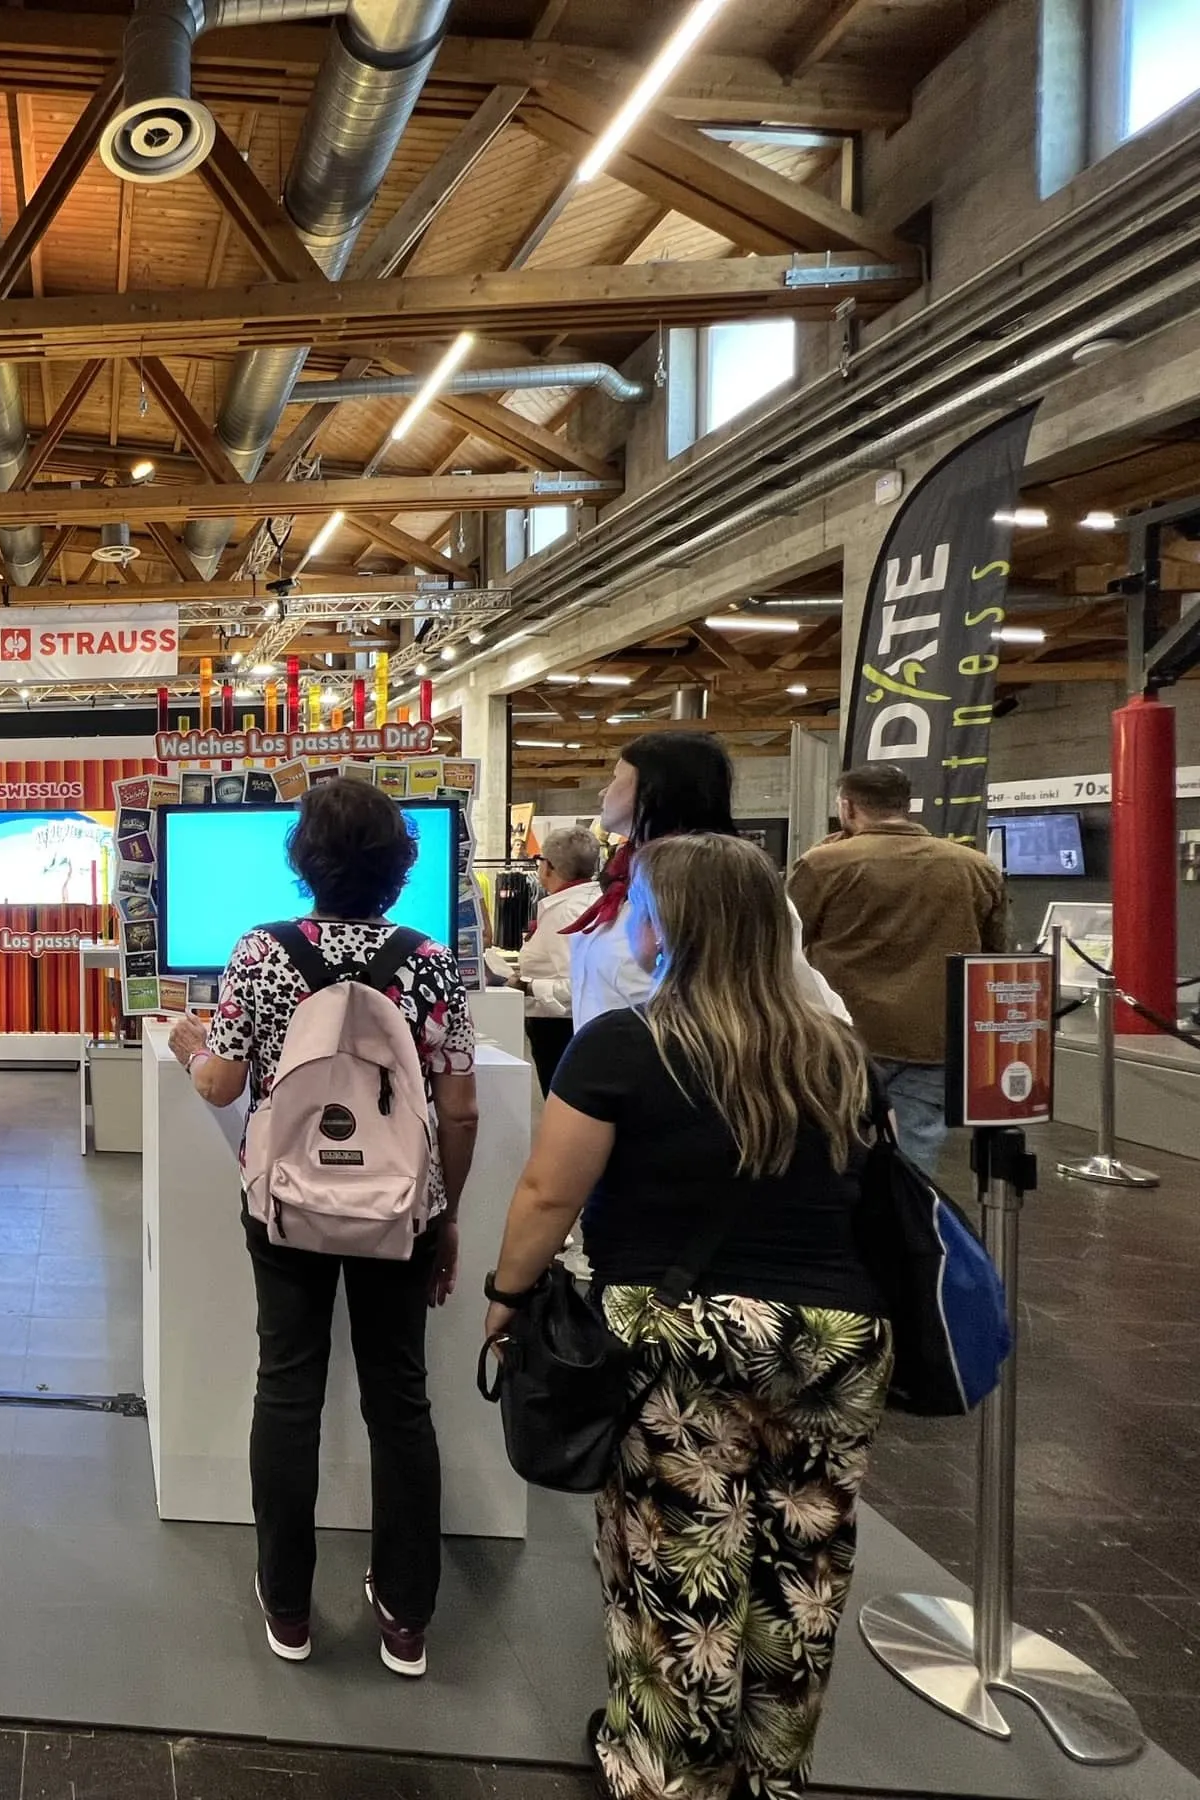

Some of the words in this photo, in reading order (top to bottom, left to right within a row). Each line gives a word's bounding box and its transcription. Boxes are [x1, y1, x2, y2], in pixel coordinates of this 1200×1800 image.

[39, 628, 176, 656] STRAUSS
[160, 735, 244, 756] Welches
[251, 730, 284, 753] Los
[292, 731, 350, 755] passt
[355, 733, 380, 749] zu
[385, 727, 428, 747] Dir?
[4, 931, 30, 949] Los
[34, 933, 80, 951] passt
